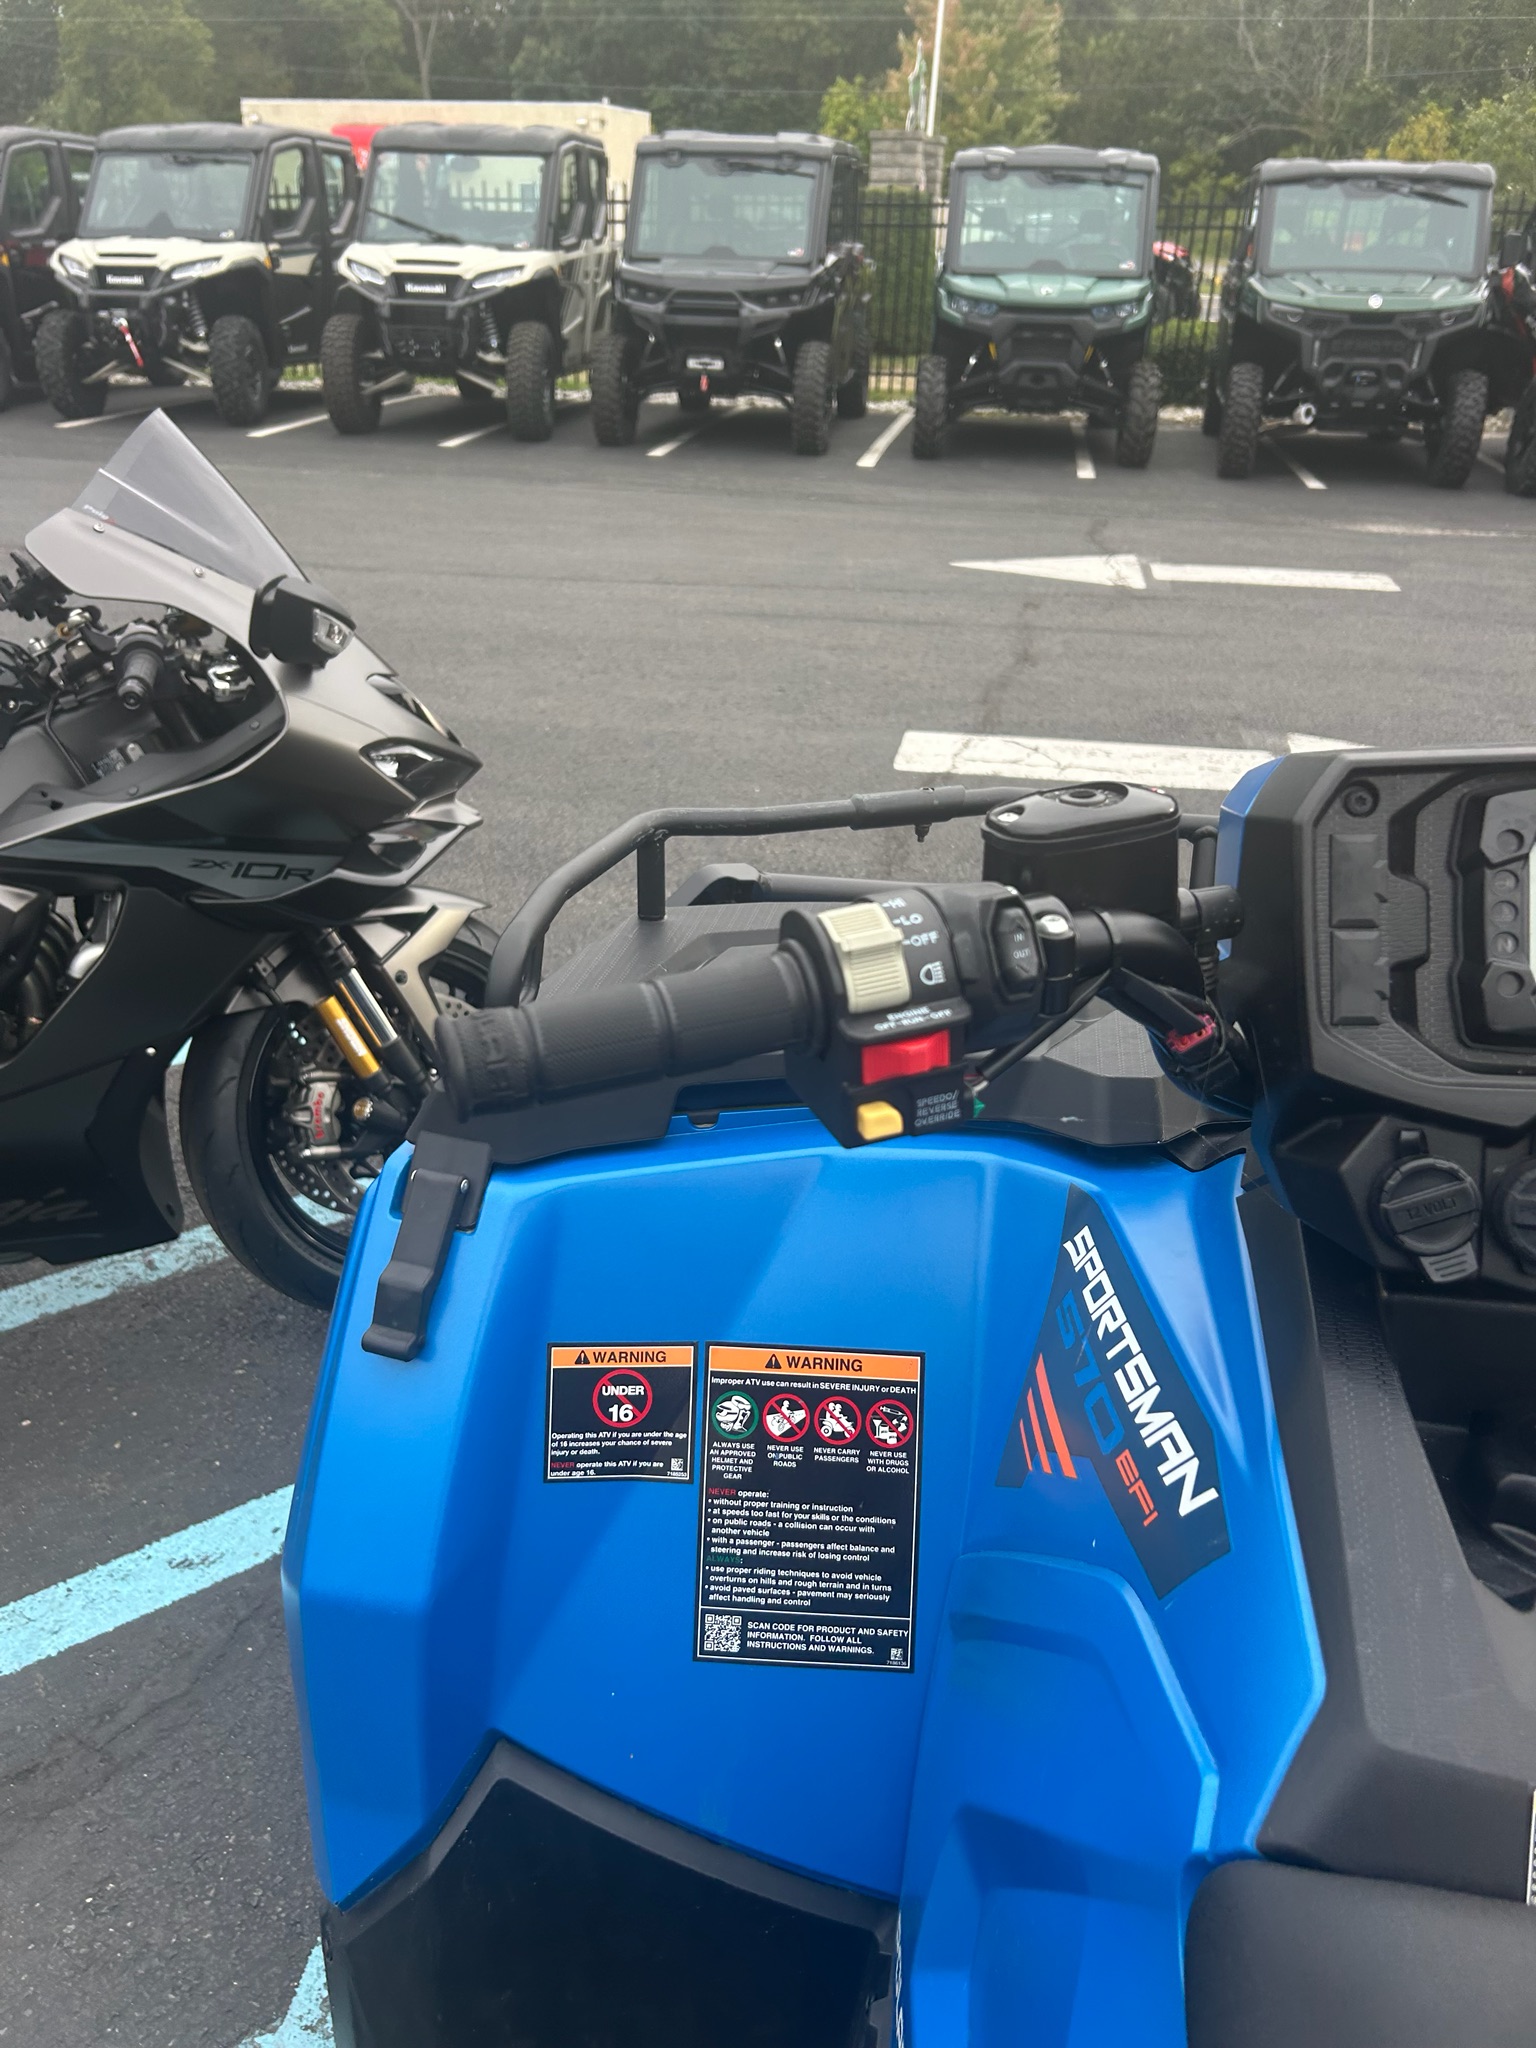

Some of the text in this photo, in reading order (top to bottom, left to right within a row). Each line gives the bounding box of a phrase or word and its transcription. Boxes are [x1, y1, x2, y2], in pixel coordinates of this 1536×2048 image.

[1014, 933, 1024, 942] IN
[1013, 948, 1030, 959] OUT
[886, 1006, 931, 1022] ENGINE
[916, 1100, 958, 1118] REVERSE
[914, 1109, 960, 1127] OVERRIDE
[593, 1351, 666, 1363] WARNING
[786, 1356, 863, 1372] WARNING
[1062, 1225, 1219, 1517] SPORTSMAN
[711, 1377, 745, 1386] Improper
[820, 1382, 851, 1391] SEVERE
[602, 1385, 645, 1397] UNDER
[608, 1403, 635, 1423] 16
[1055, 1288, 1159, 1528] 570 EFI
[770, 1501, 800, 1511] training
[812, 1504, 854, 1512] instruction
[706, 1555, 744, 1564] ALWAYS:
[710, 1546, 742, 1556] steering
[758, 1549, 791, 1557] increase
[818, 1552, 841, 1562] losing
[753, 1568, 776, 1577] riding
[777, 1569, 820, 1578] techniques
[732, 1595, 766, 1605] handling
[854, 1593, 890, 1602] seriously
[747, 1622, 771, 1630] SCAN
[772, 1623, 796, 1631] CODE
[816, 1626, 856, 1634] PRODUCT
[876, 1628, 908, 1637] SAFETY
[747, 1631, 806, 1641] INFORMATION.
[810, 1635, 845, 1643] FOLLOW
[747, 1641, 807, 1650] INSTRUCTIONS
[828, 1645, 875, 1654] WARNINGS.
